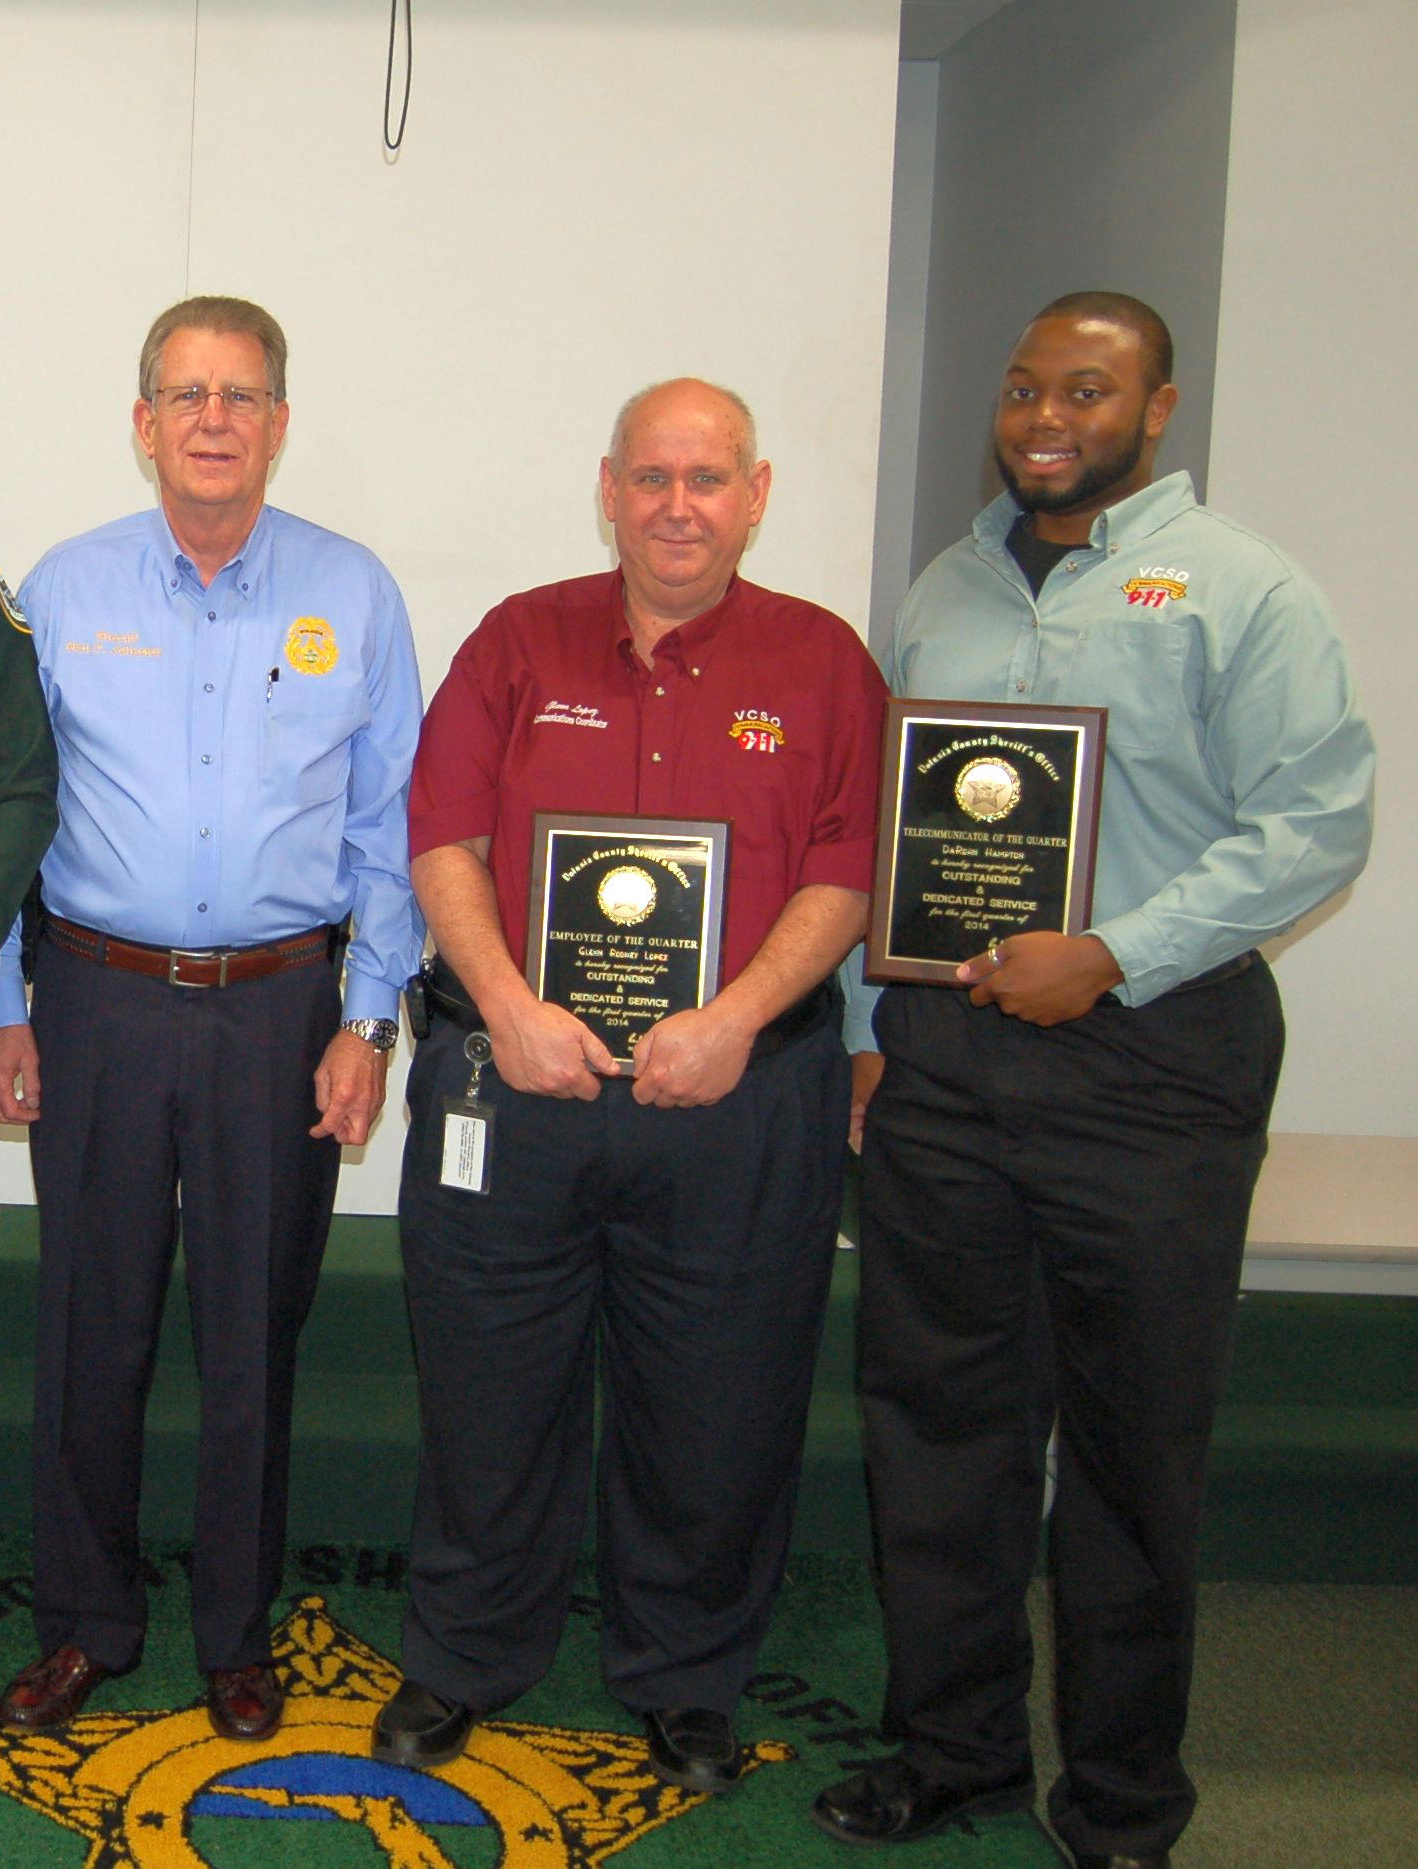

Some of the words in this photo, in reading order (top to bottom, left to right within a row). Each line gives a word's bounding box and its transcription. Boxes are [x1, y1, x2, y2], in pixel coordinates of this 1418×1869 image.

[1138, 566, 1189, 582] VCSO
[734, 710, 780, 727] VCSO
[951, 738, 988, 751] County
[904, 827, 990, 842] TELECOMMUNICATOR
[992, 833, 1004, 842] OF
[1007, 835, 1023, 844] THE
[1026, 836, 1067, 848] QUARTER
[592, 848, 626, 860] County
[942, 871, 1021, 886] OUTSTANDING
[922, 893, 984, 907] DEDICATED
[990, 899, 1037, 910] SERVICE
[945, 908, 959, 916] the
[1017, 914, 1029, 924] of
[964, 921, 990, 931] 2014
[549, 931, 603, 944] EMPLOYEE
[607, 935, 621, 944] OF
[624, 936, 644, 946] THE
[648, 938, 698, 950] QUARTER
[586, 972, 655, 984] OUTSTANDING
[570, 992, 623, 1004] DEDICATED
[628, 997, 669, 1008] SERVICE
[588, 1007, 601, 1015] the
[654, 1012, 665, 1020] of
[606, 1018, 629, 1026] 2014
